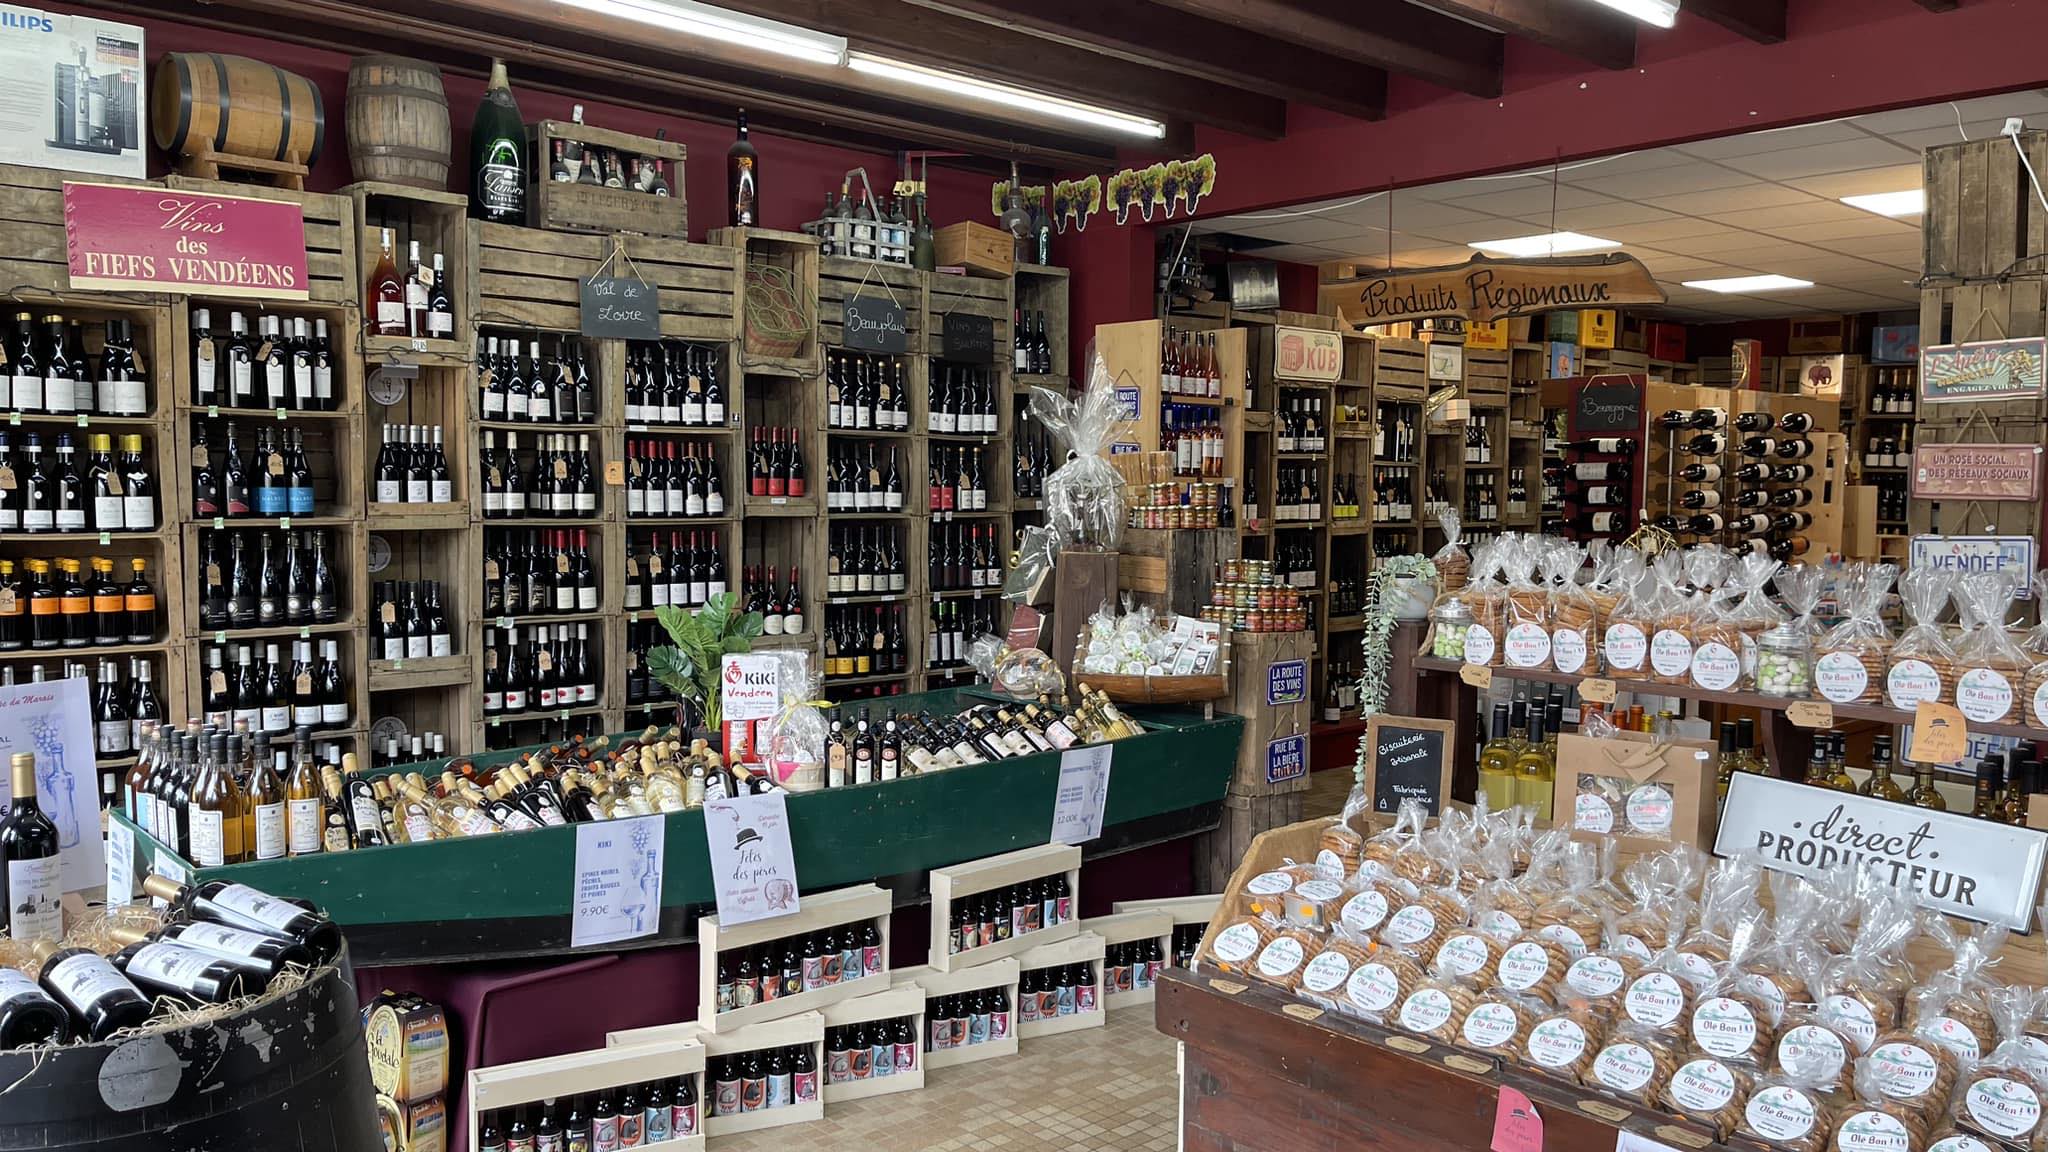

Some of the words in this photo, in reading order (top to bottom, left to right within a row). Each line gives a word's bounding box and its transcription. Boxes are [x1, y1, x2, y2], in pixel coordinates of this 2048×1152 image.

[158, 199, 225, 233] Vins
[176, 235, 207, 254] des
[85, 252, 156, 278] FIEFS
[168, 257, 295, 287] VENDÉENS
[593, 280, 616, 297] Val
[624, 284, 639, 298] de
[1361, 280, 1457, 318] Produits
[1466, 269, 1610, 315] Régionaux
[598, 305, 646, 322] Loire
[1306, 347, 1337, 371] KUB
[1933, 455, 1946, 465] UN
[1949, 451, 1972, 465] ROSÉ
[1928, 468, 1946, 479] DES
[1949, 466, 1988, 479] RÉSEAUX
[1990, 469, 2030, 480] SOCIAUX
[745, 672, 776, 686] KiKi
[1272, 668, 1281, 680] LA
[1281, 665, 1303, 679] ROUTE
[1272, 680, 1286, 692] DES
[1286, 678, 1302, 690] VINS
[1274, 741, 1287, 754] RUE
[1288, 740, 1297, 751] DE
[1273, 756, 1281, 768] LA
[1282, 752, 1300, 765] BIÈRE
[1809, 804, 1935, 860] direct
[732, 862, 749, 881] des
[580, 904, 609, 917] 9.90€
[375, 1030, 383, 1045] la
